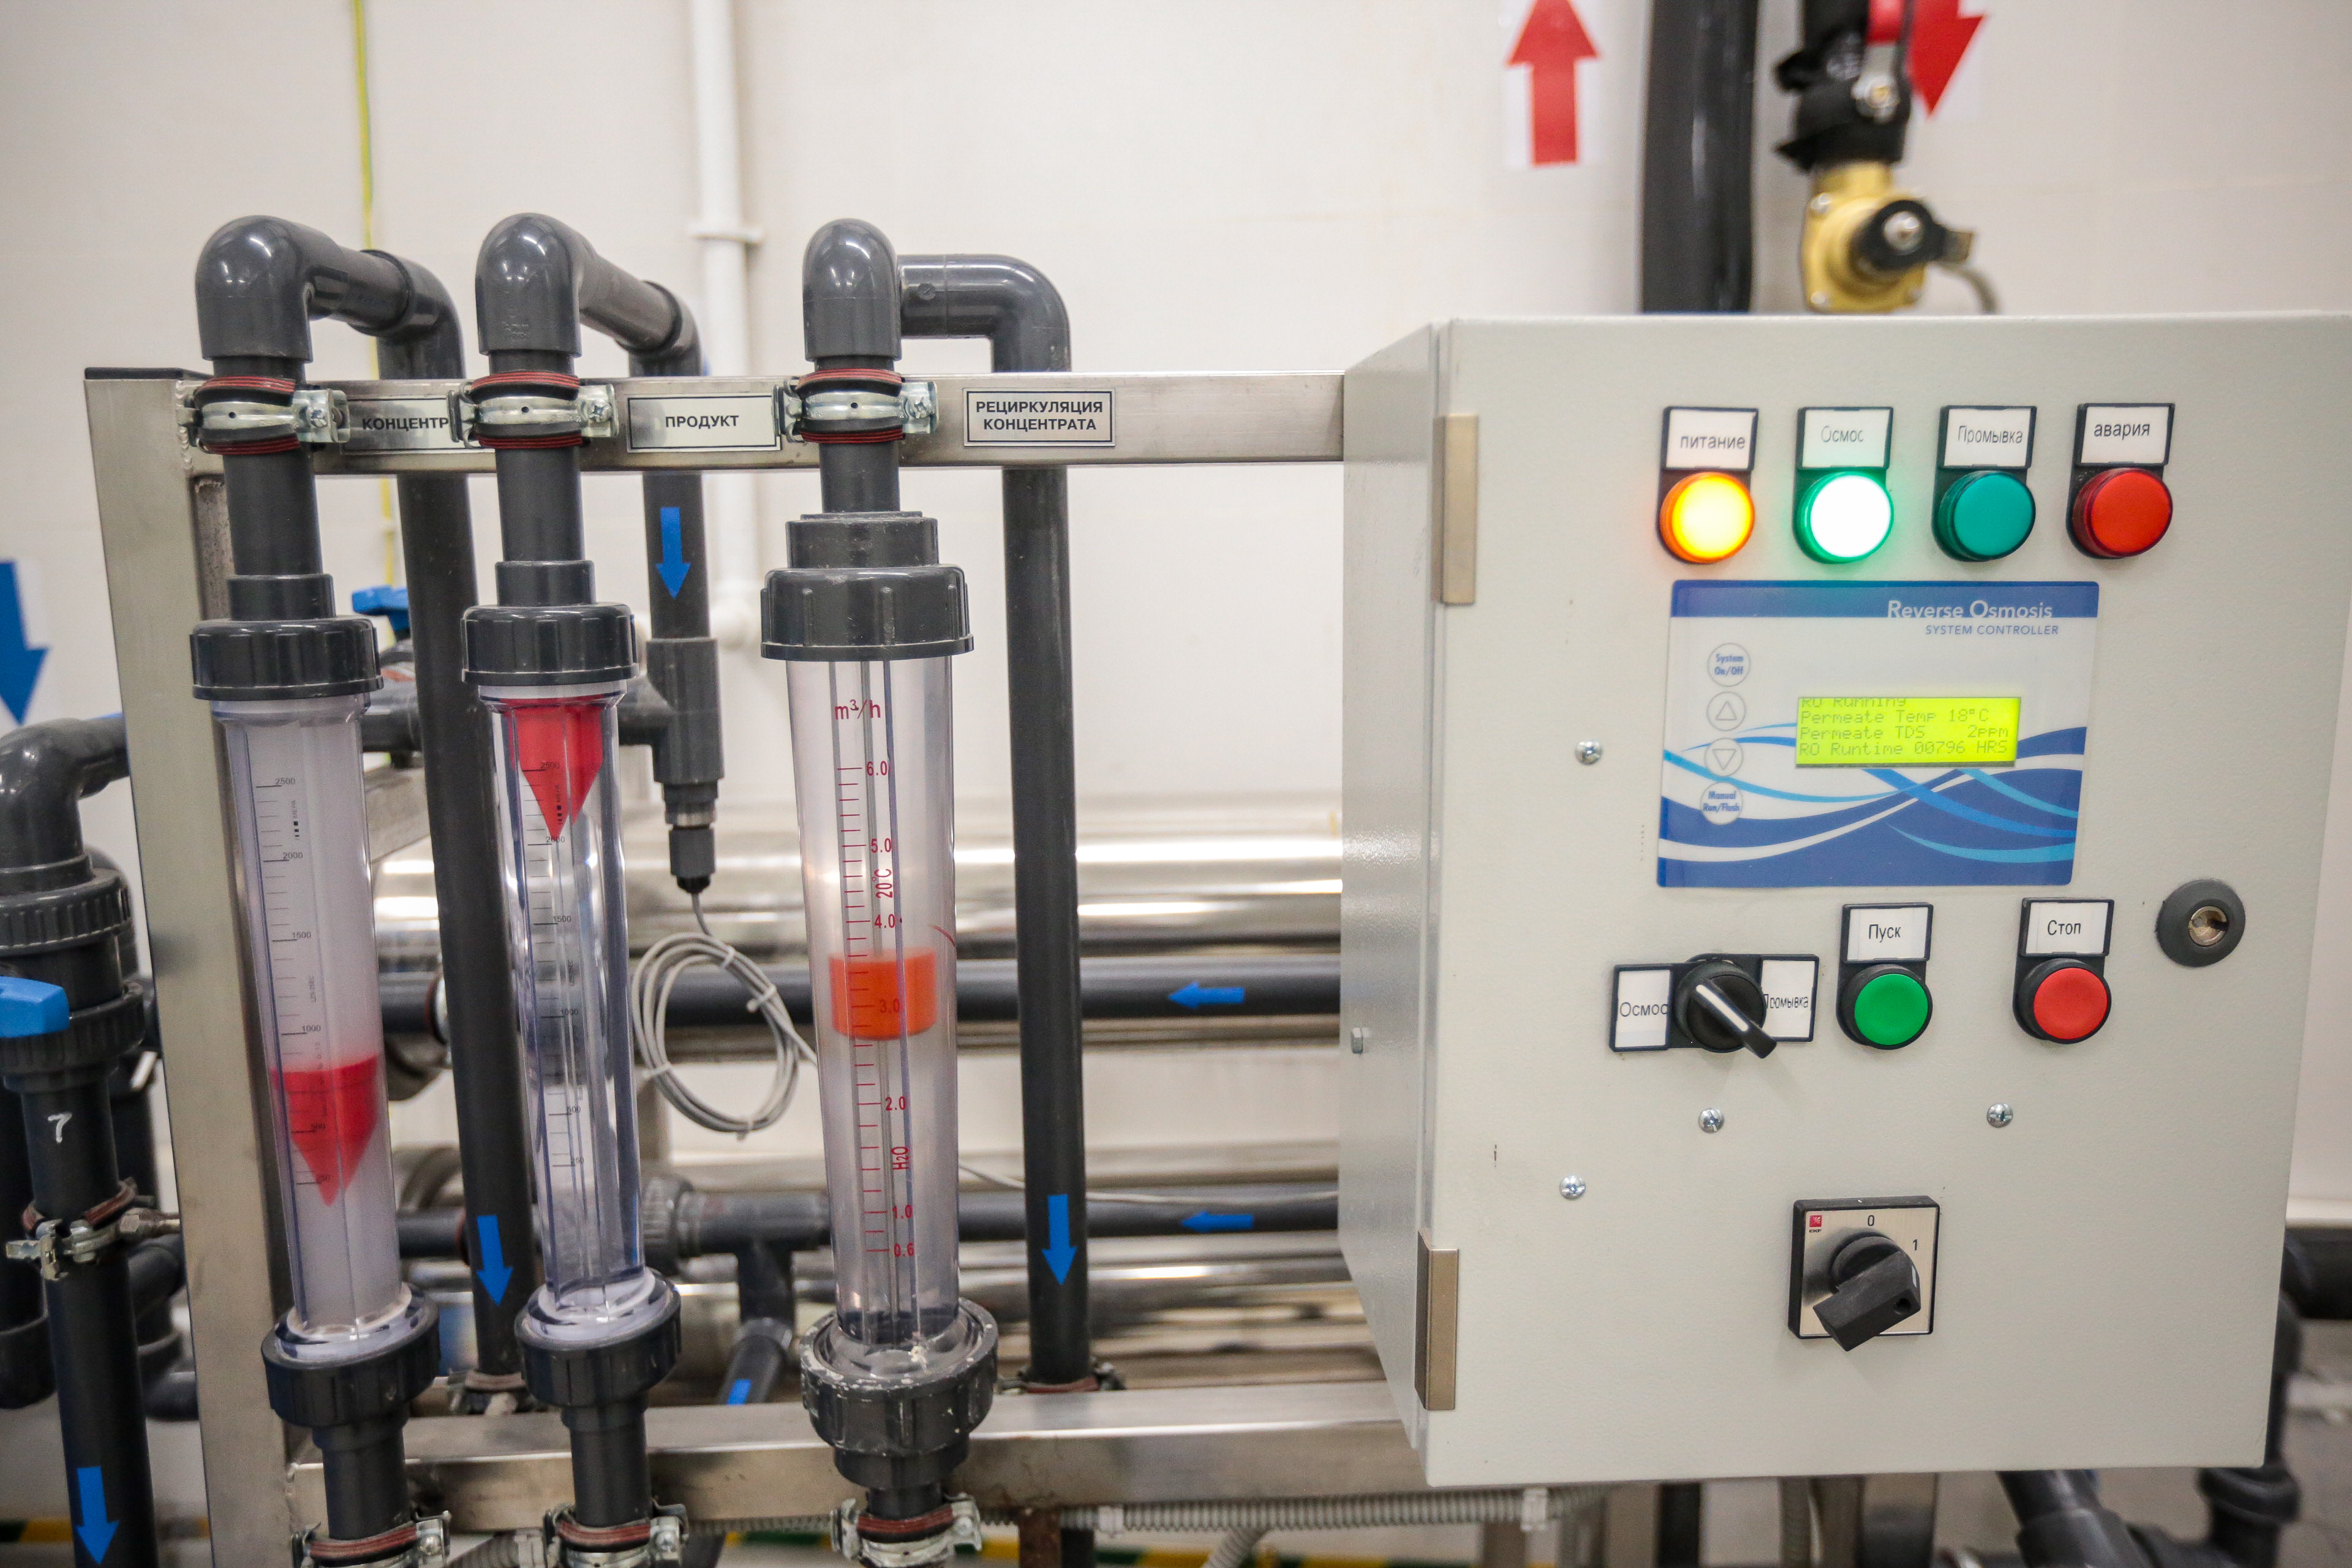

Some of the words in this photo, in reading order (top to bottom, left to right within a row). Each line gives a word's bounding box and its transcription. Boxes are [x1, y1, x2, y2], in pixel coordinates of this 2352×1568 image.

[976, 401, 1103, 415] РЕЦИРКУЛЯЦИЯ
[665, 415, 739, 429] ПРОДУКТ
[984, 419, 1097, 432] КОНЦЕНТРАТА
[1820, 425, 1864, 443] Осмос
[1958, 425, 2023, 445] Промывка
[2094, 423, 2150, 440] авария
[1680, 435, 1745, 451] питание
[1887, 600, 1964, 618] Reverse
[1969, 600, 2052, 618] Osmosis
[1925, 625, 1973, 635] SYSTEM
[1977, 625, 2059, 635] CONTROLLER
[1715, 654, 1744, 663] System
[1714, 666, 1744, 676] On/Off
[1801, 710, 1885, 724] Permeate
[1896, 709, 1937, 723] Temp
[1800, 726, 1883, 740] Permeate
[1895, 725, 1926, 739] TDS
[1799, 742, 1820, 756] RO
[1831, 742, 1903, 756] Runtime
[1914, 741, 1966, 755] 00796
[1977, 740, 2008, 754] HRS
[866, 761, 888, 776] 6.0
[1708, 790, 1736, 800] Manual
[1703, 803, 1740, 813] Run/Flush
[871, 837, 892, 853] 5.0
[874, 913, 896, 929] 4.0
[2047, 919, 2081, 936] Стоп
[1868, 924, 1901, 943] Пуск
[879, 998, 900, 1014] 3.0
[884, 1096, 907, 1111] 2.0
[47, 1112, 73, 1144] 7
[892, 1205, 913, 1219] 1.0
[1868, 1215, 1875, 1226] 0
[893, 1244, 915, 1257] 0.6
[1912, 1239, 1918, 1251] 1
